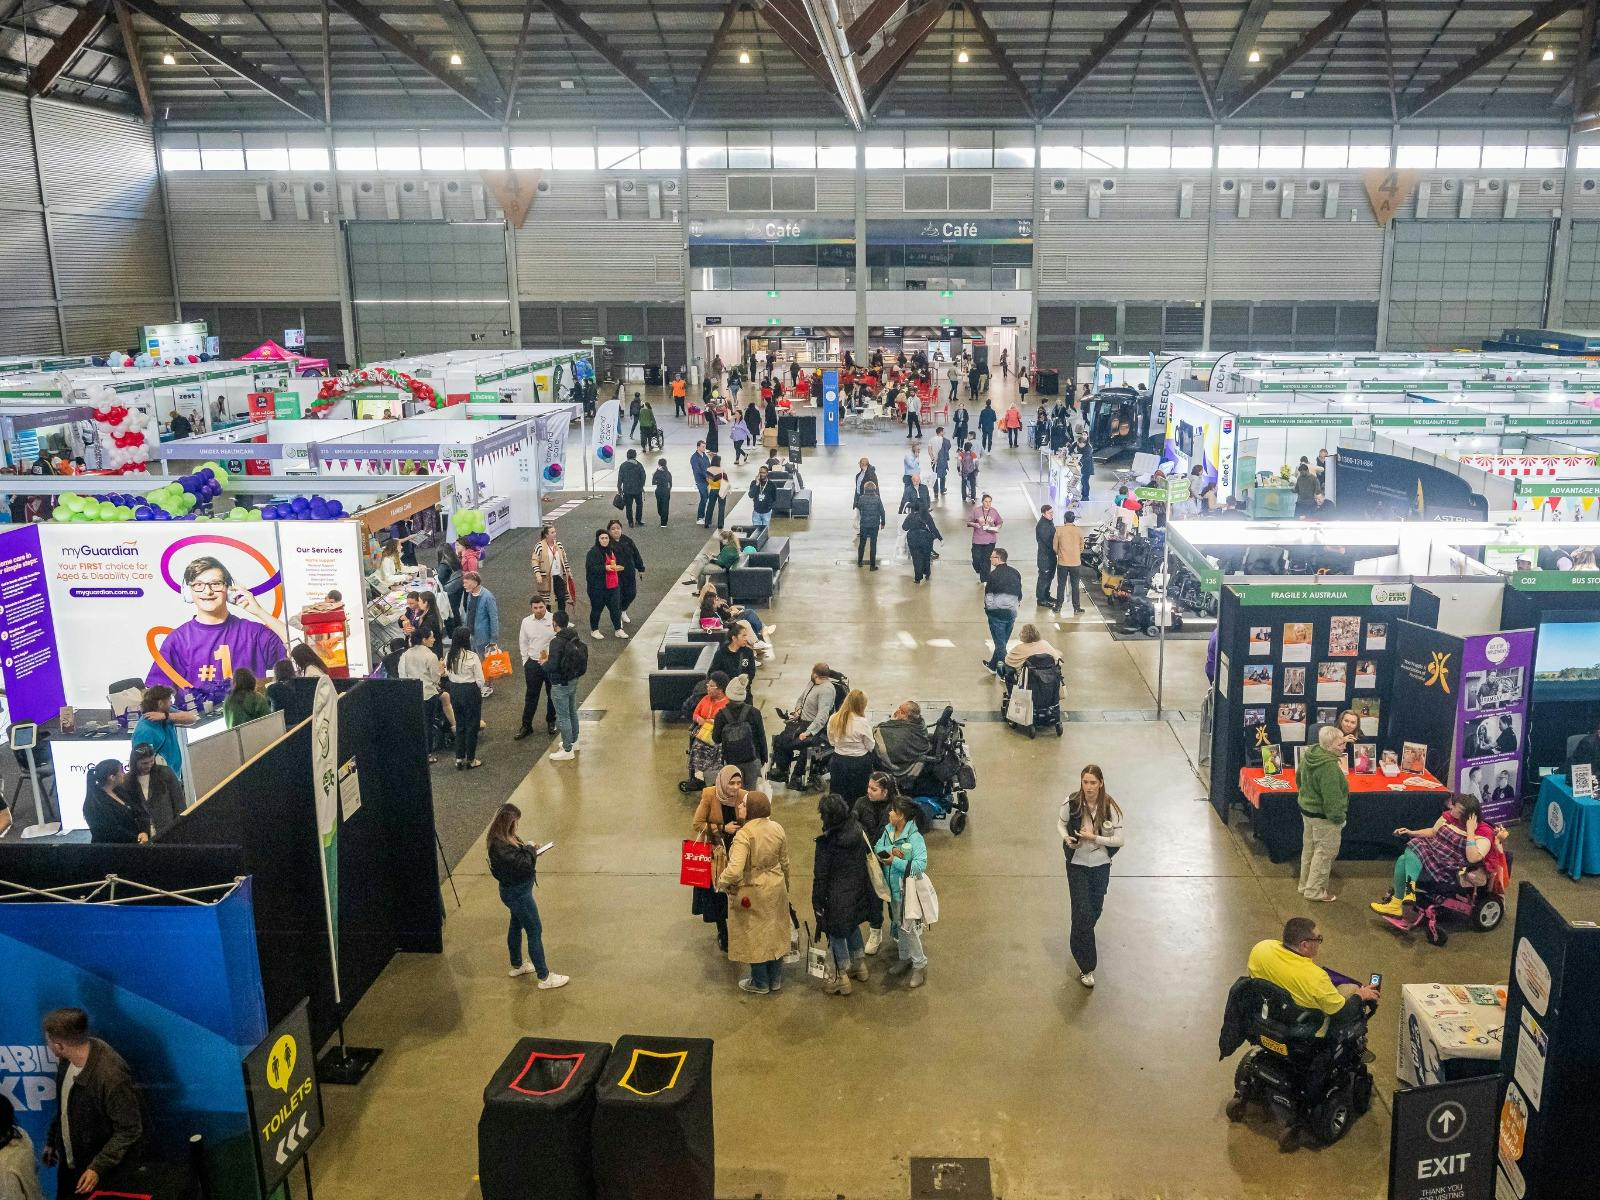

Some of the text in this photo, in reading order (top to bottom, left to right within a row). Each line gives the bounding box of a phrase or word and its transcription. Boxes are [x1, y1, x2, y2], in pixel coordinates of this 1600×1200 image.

[765, 222, 800, 237] Café
[942, 222, 978, 237] Café
[1157, 371, 1172, 425] FREEDOM
[62, 545, 139, 559] myGuardian
[0, 558, 13, 567] ome
[58, 562, 148, 570] Your FIRST choice for
[57, 572, 154, 581] Aged & Disability Care
[1205, 577, 1217, 585] 135
[1521, 577, 1537, 585] C02
[1571, 577, 1585, 585] BUS
[75, 589, 138, 597] myguardian.com.au
[1271, 591, 1348, 599] FRAGILE X AUSTRALIA
[198, 644, 234, 682] #1
[262, 1077, 312, 1142] TOILETS
[1418, 1152, 1471, 1180] EXIT
[1421, 1183, 1463, 1197] THANK YOU
[1435, 1191, 1464, 1200] VISITING
